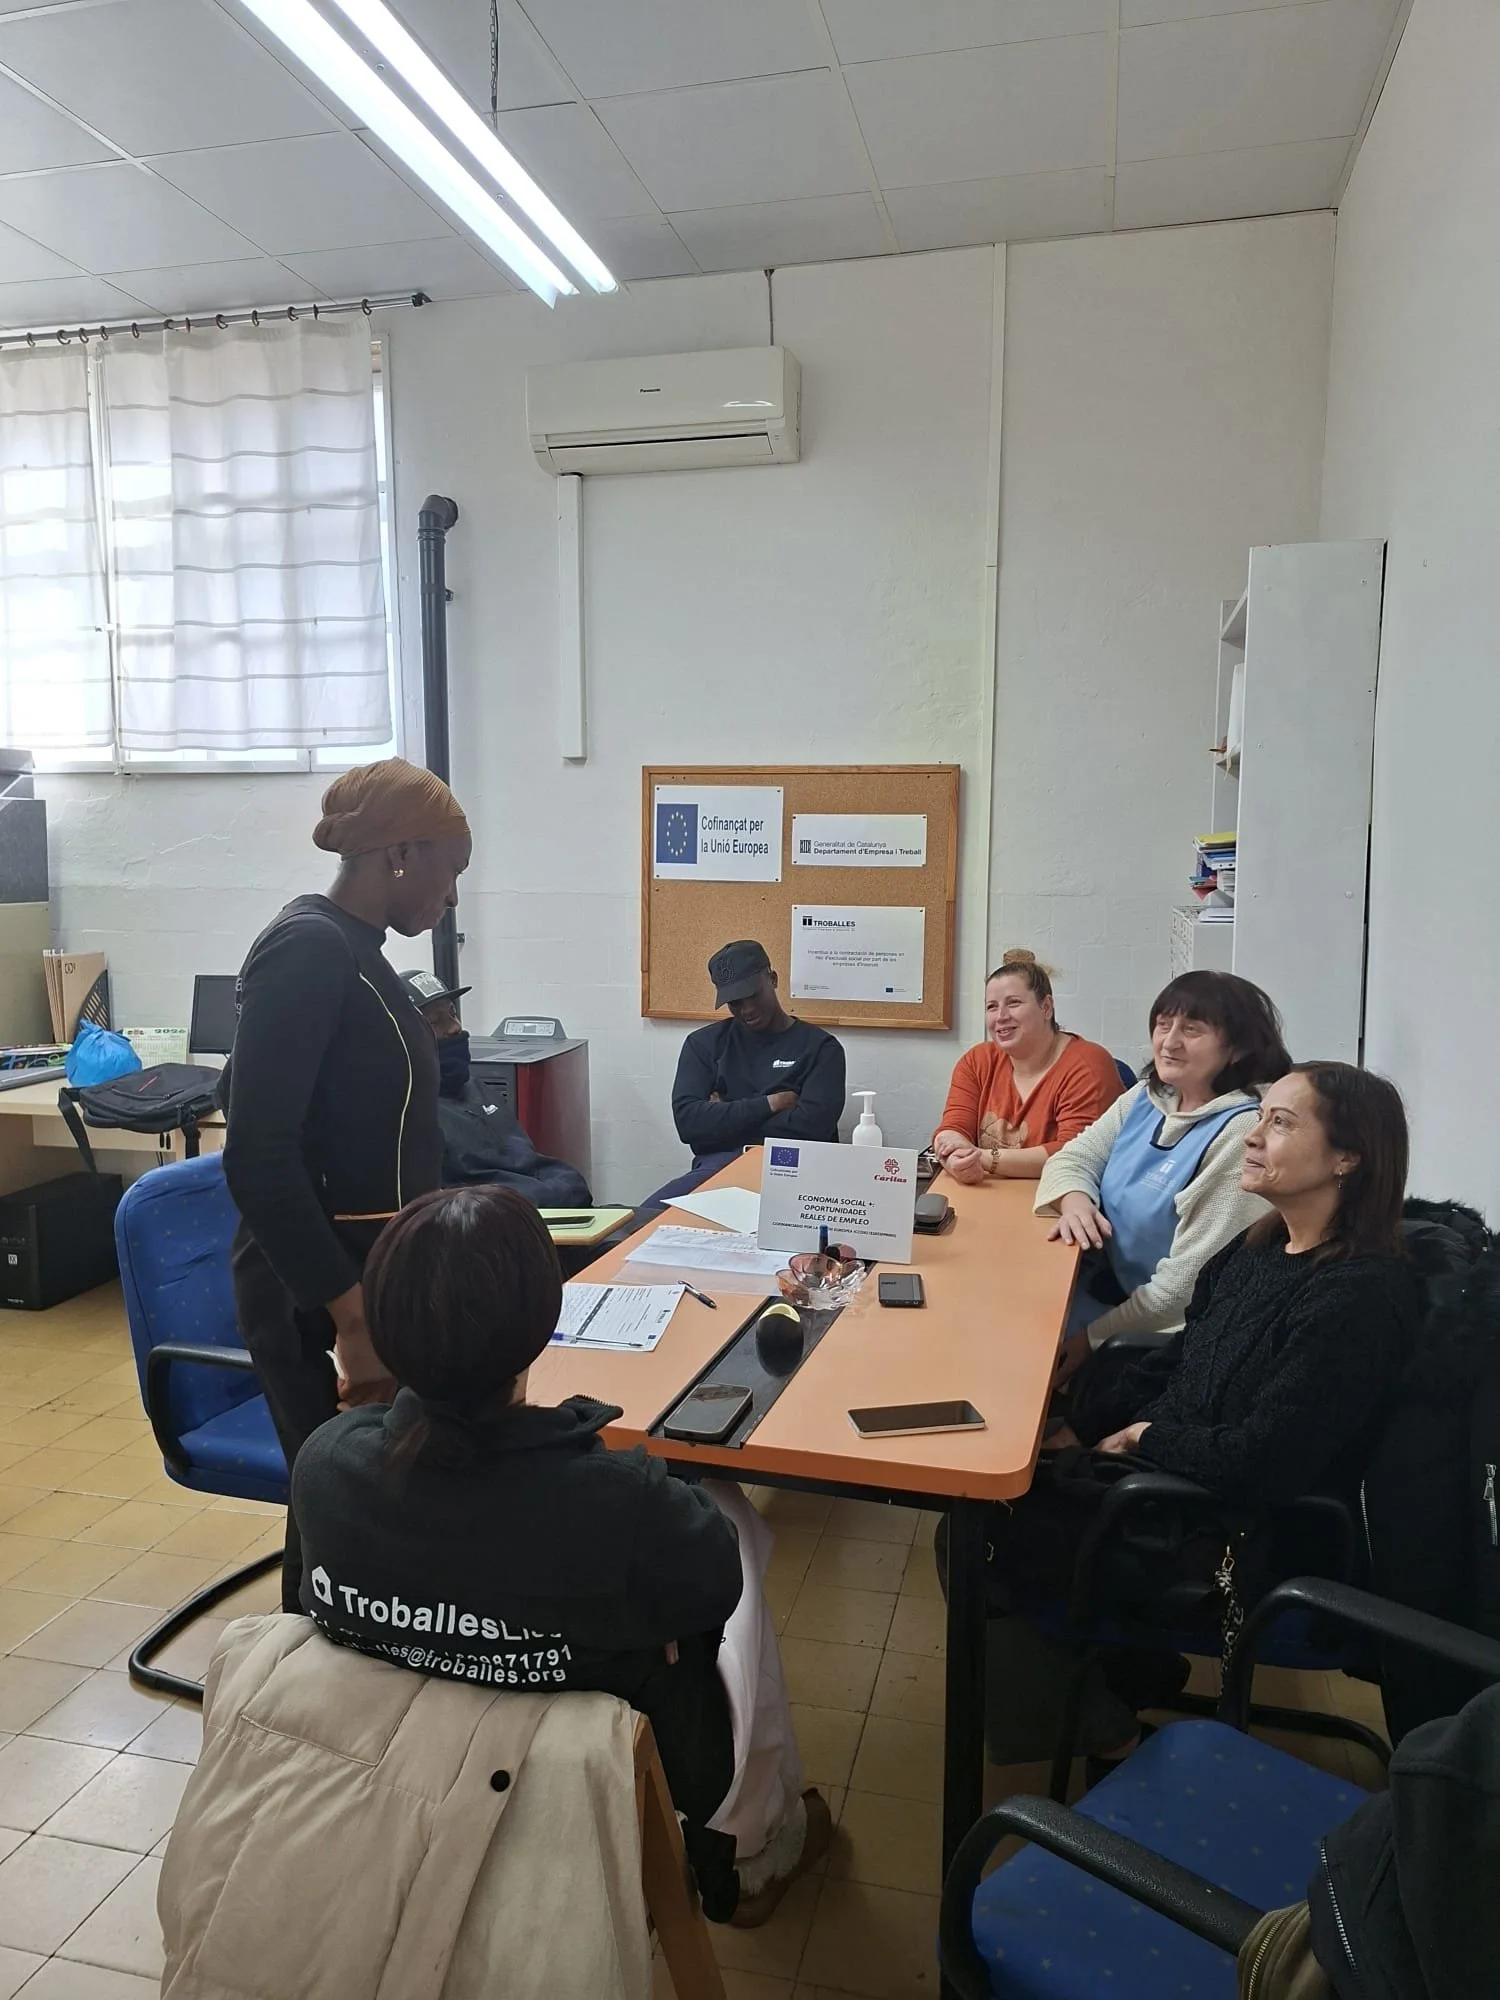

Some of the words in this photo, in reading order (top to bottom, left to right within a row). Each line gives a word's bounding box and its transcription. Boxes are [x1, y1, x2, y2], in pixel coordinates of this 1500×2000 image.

[701, 815, 748, 835] Cofinançat
[749, 820, 764, 836] per
[700, 838, 709, 853] la
[710, 838, 731, 853] Unió
[732, 839, 769, 857] Europea
[813, 840, 846, 848] Generalitat
[856, 841, 887, 849] Catalunya
[813, 848, 857, 856] Departament
[858, 848, 894, 856] d'Empresa
[899, 848, 922, 856] Treball
[813, 920, 856, 928] TROBALLES
[840, 1198, 867, 1207] SOCIAL
[804, 1205, 867, 1216] OPORTUNIDADES
[800, 1213, 827, 1222] REALES
[839, 1217, 870, 1226] EMPLEO
